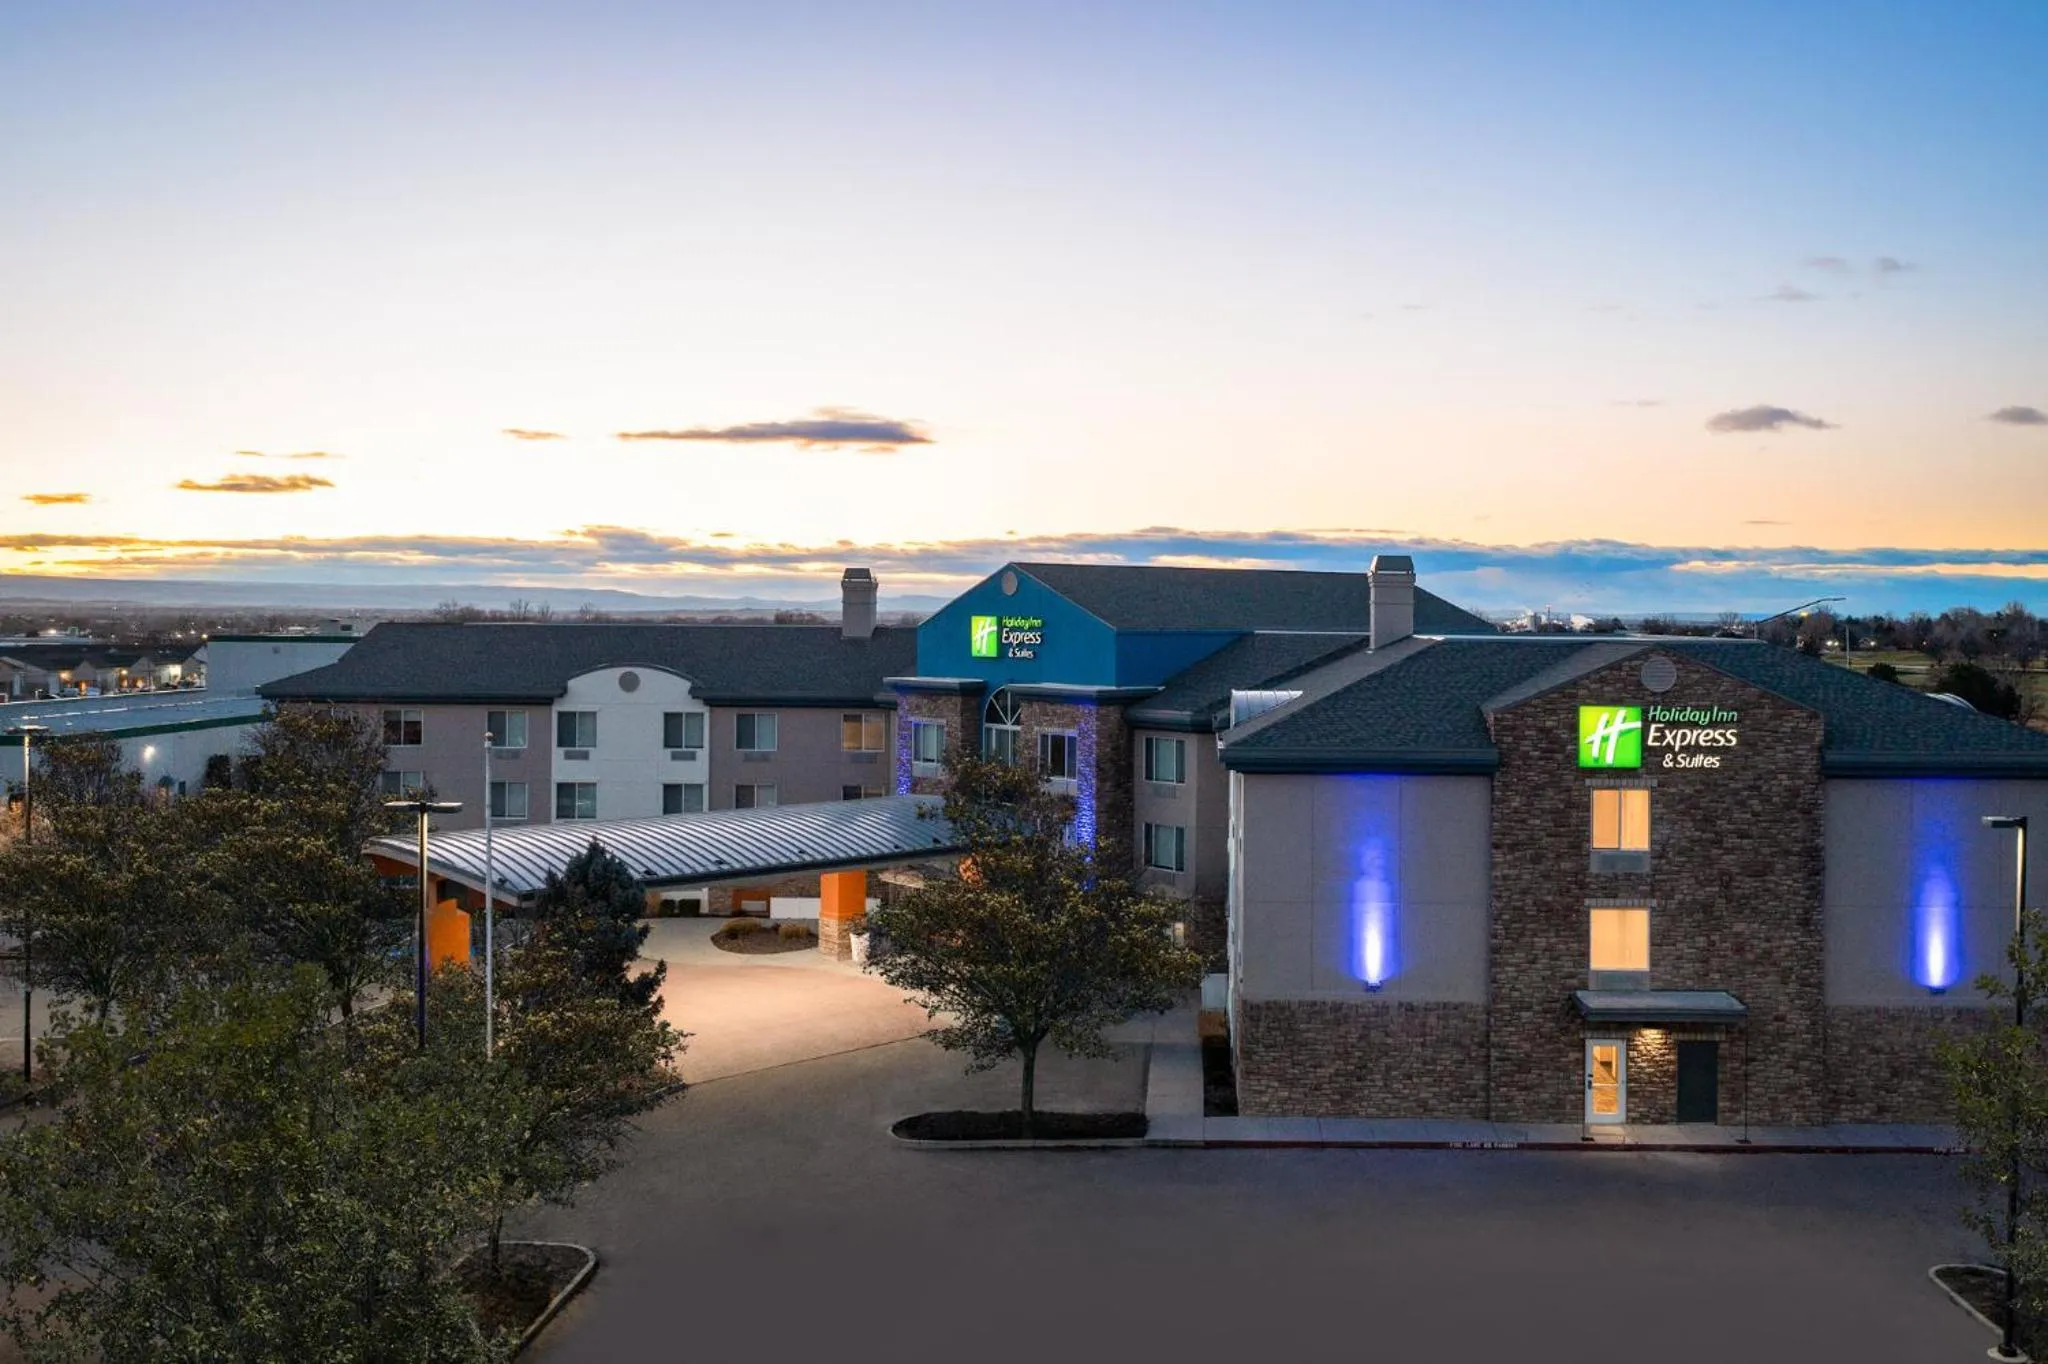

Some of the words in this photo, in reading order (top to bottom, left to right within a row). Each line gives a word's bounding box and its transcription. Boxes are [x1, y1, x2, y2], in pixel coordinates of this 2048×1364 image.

[1002, 628, 1041, 646] Express
[1008, 648, 1014, 657] &
[1014, 648, 1034, 658] Suites
[1648, 705, 1711, 725] Holiday
[1711, 705, 1738, 723] Inn
[1647, 724, 1738, 751] Express
[1662, 753, 1674, 768] &
[1676, 753, 1721, 768] Suites
